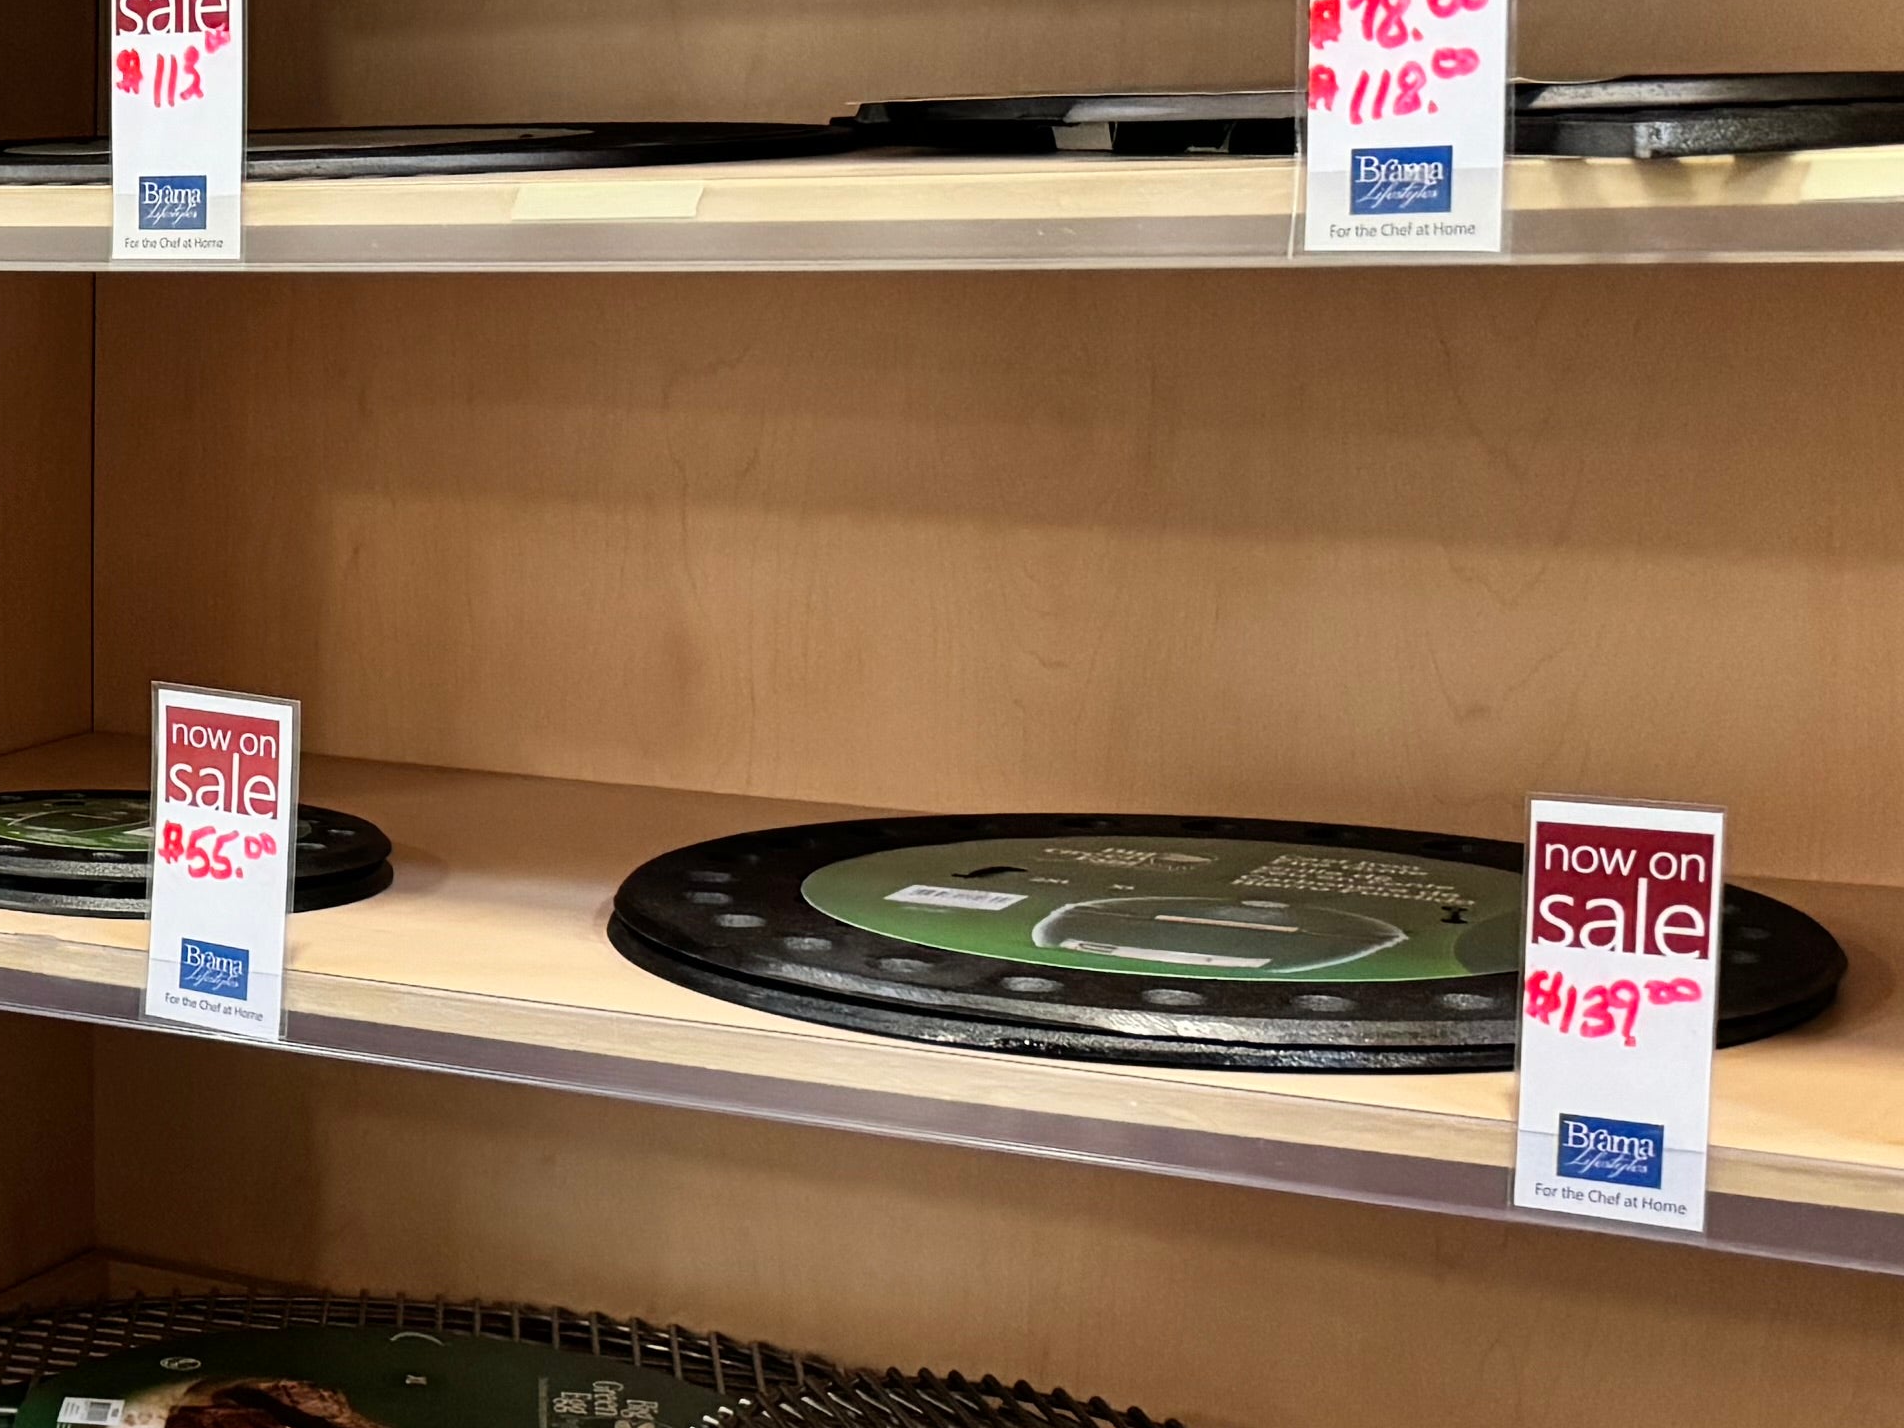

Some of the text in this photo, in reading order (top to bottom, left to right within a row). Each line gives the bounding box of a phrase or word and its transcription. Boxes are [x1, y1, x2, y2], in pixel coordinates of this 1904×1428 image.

[1355, 155, 1444, 185] Brama
[144, 182, 202, 207] Brama
[1330, 222, 1476, 238] For the Chef at Home
[172, 722, 276, 759] now on
[168, 752, 277, 819] sale
[1544, 843, 1706, 883] now on
[1538, 877, 1706, 959] sale
[184, 944, 243, 977] Brama
[1562, 1120, 1655, 1158] Brama
[1535, 1183, 1687, 1215] For the Chef at Home
